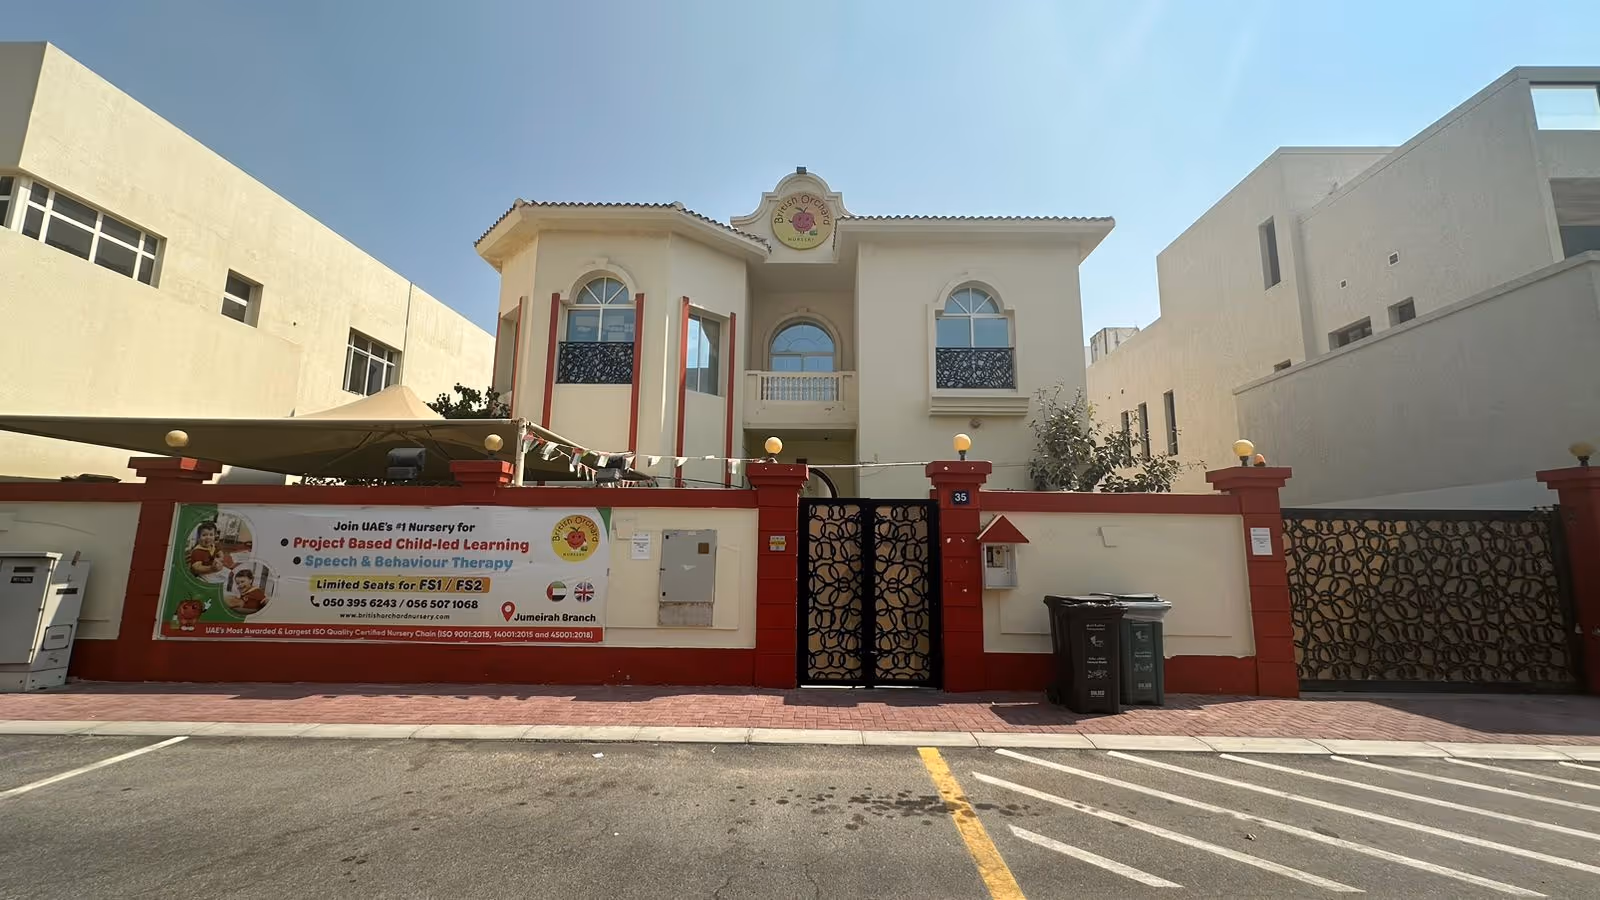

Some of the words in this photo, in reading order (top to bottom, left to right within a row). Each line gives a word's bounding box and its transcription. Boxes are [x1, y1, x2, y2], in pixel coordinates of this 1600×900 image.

[774, 197, 798, 224] British
[801, 194, 830, 226] Orchard
[954, 493, 967, 502] 35
[333, 521, 359, 531] Join
[362, 521, 393, 531] UAE's
[396, 522, 406, 531] #1
[408, 522, 455, 534] Nursery
[457, 522, 475, 532] for
[552, 518, 573, 542] British
[575, 516, 599, 542] Orchard
[293, 536, 345, 551] Project
[348, 538, 392, 549] Based
[396, 537, 460, 550] Child-led
[464, 538, 529, 553] Learning
[305, 555, 357, 568] Speech
[361, 555, 371, 568] &
[375, 555, 449, 568] Behaviour
[452, 556, 514, 572] Therapy
[316, 579, 360, 589] Limited
[362, 580, 395, 590] Seats
[399, 580, 416, 590] for
[419, 579, 442, 590] FS1
[445, 579, 453, 591] /
[456, 579, 482, 591] FS2
[322, 598, 344, 607] 050
[346, 598, 367, 607] 395
[369, 598, 397, 608] 6243
[399, 599, 405, 608] /
[406, 599, 428, 608] 056
[430, 600, 450, 609] 507
[452, 600, 479, 609] 1068
[514, 613, 560, 622] Jumeirah
[562, 613, 596, 622] Branch
[284, 628, 311, 636] Largest
[387, 630, 414, 638] Nursery
[437, 630, 452, 638] (ISO
[454, 630, 492, 639] 9001:2015,
